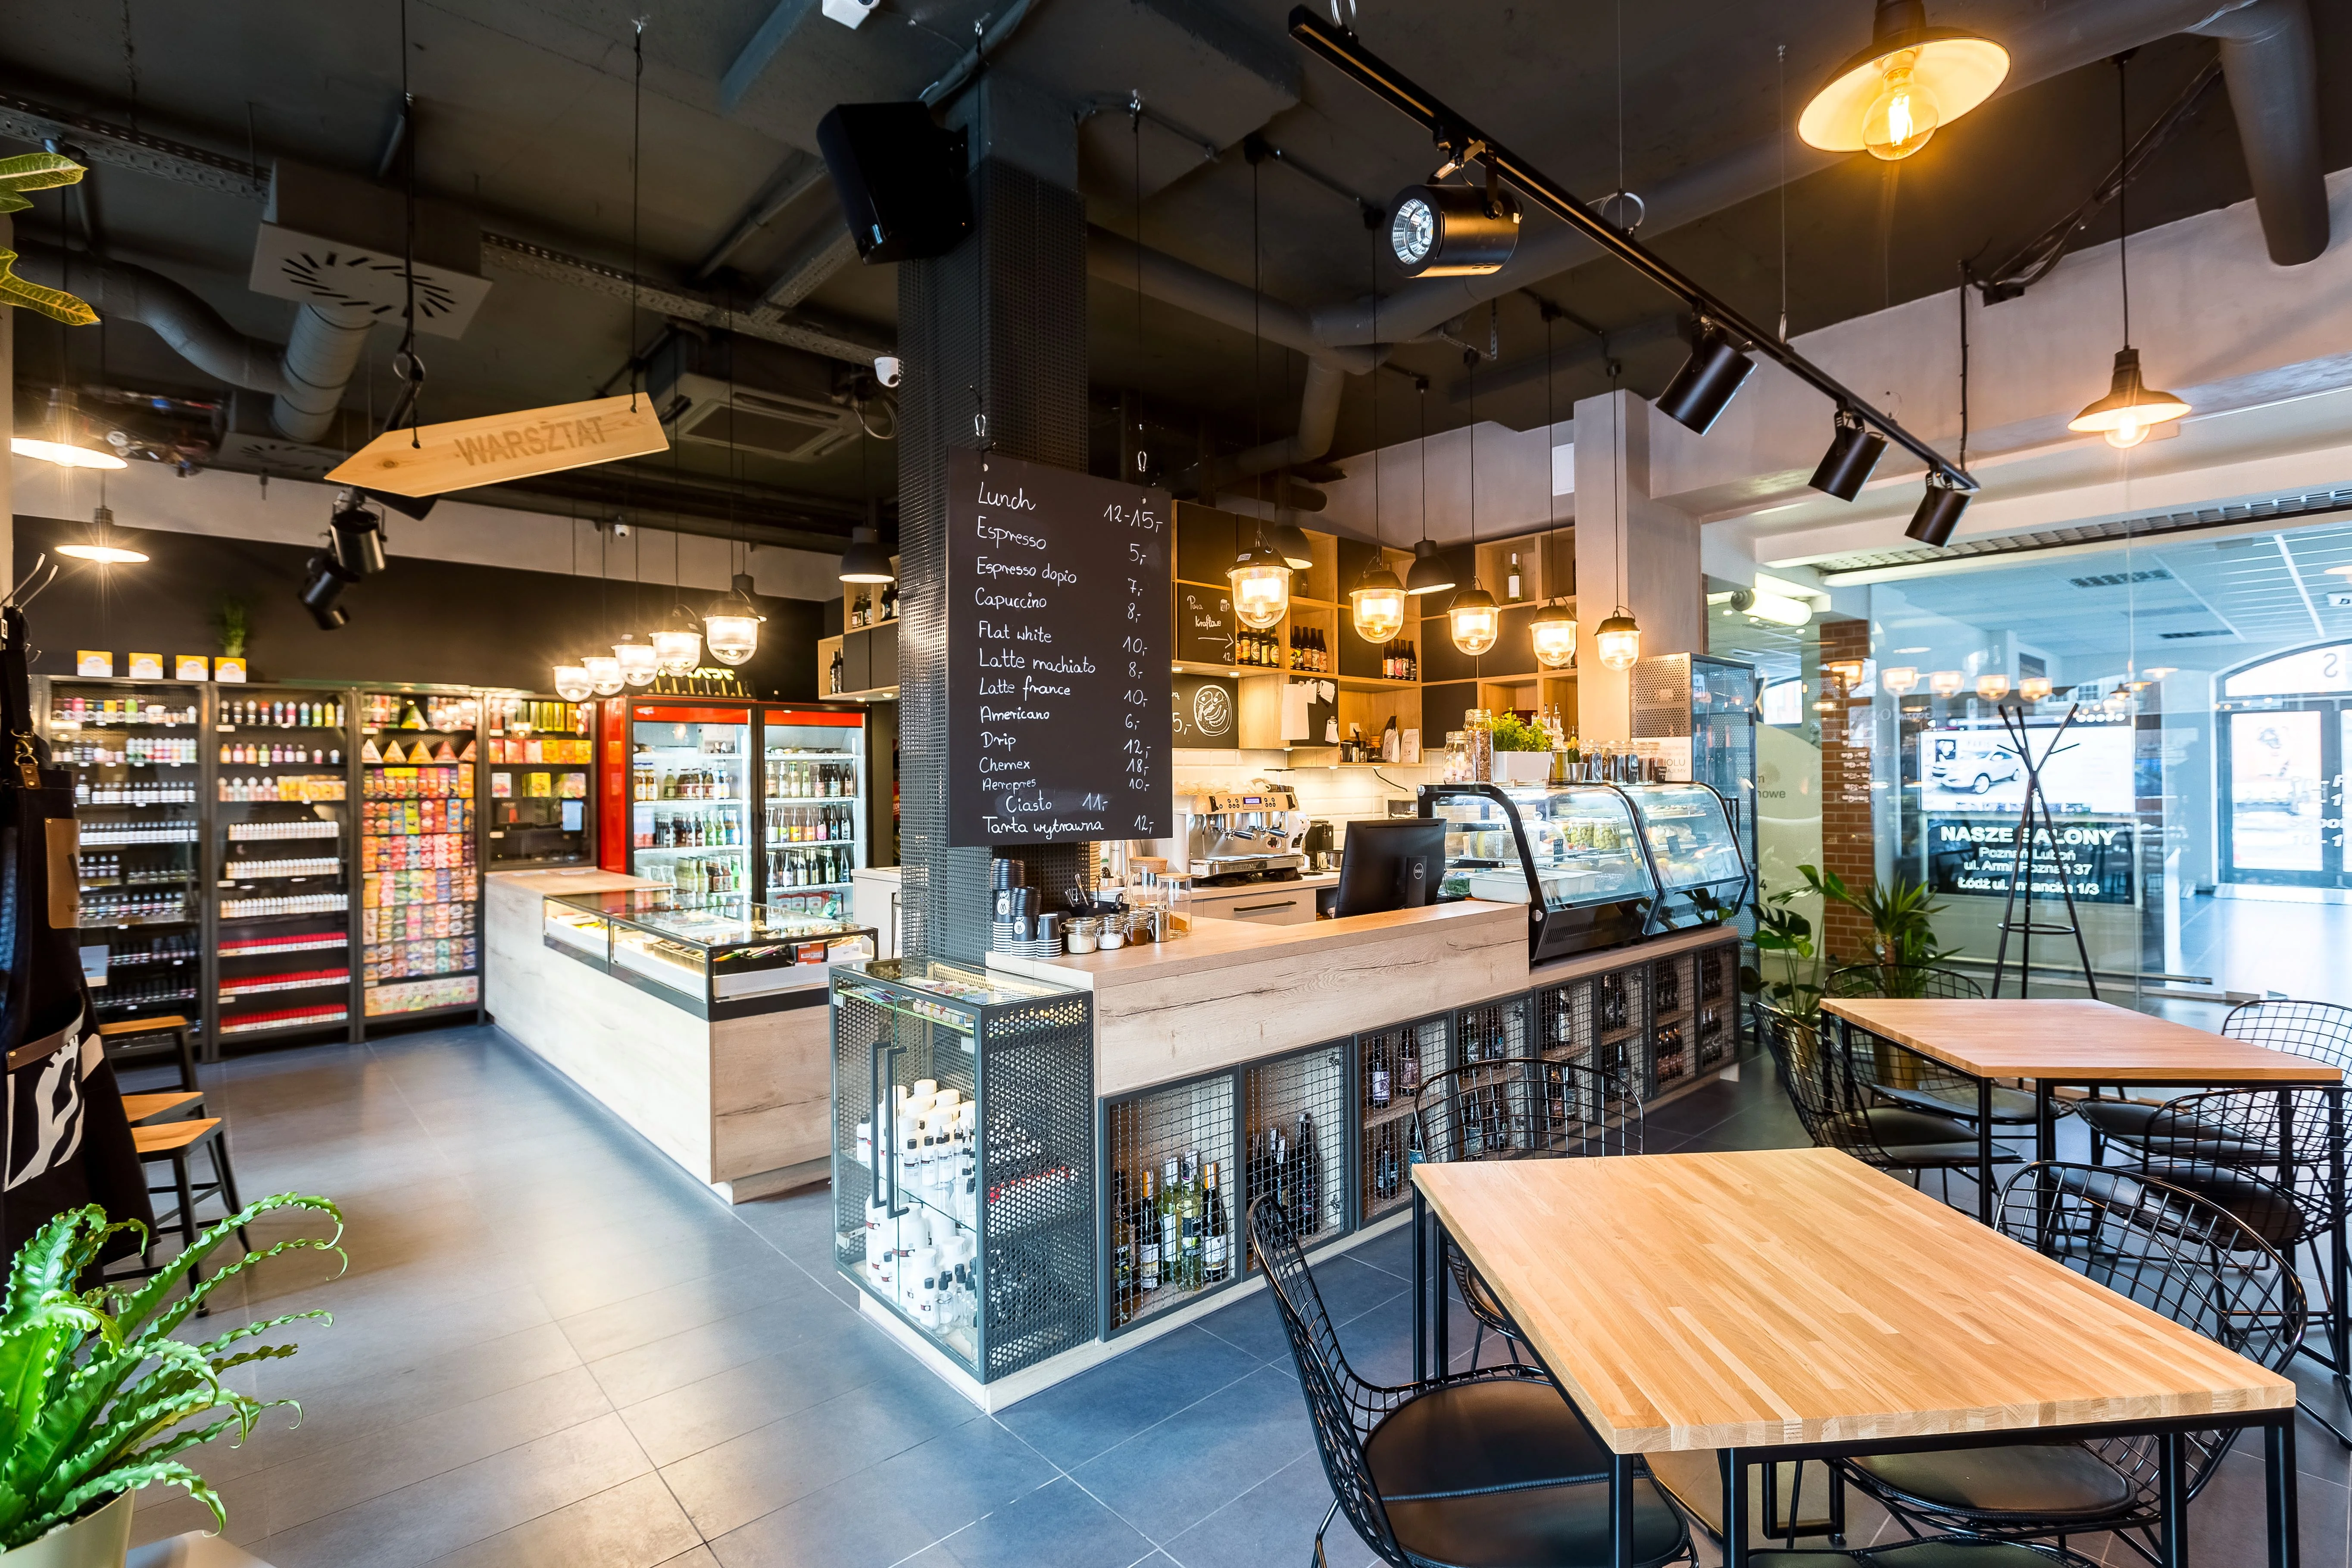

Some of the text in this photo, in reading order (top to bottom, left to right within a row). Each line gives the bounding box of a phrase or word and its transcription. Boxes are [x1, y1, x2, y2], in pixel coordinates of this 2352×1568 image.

[454, 416, 606, 466] WARSZTAT
[978, 481, 1036, 510] Lunch
[977, 515, 1046, 550] Espresso
[977, 556, 1037, 580] Espresso
[1042, 563, 1077, 587] dopio
[975, 587, 1047, 610] Capuccino
[979, 620, 1010, 639] Flat
[1017, 625, 1052, 643] white
[979, 647, 1025, 668] Latte
[1033, 655, 1096, 673] machiato
[979, 677, 1015, 695] Latte
[1022, 675, 1071, 701] france
[980, 706, 1050, 724] Americano
[980, 731, 1016, 752] Drip
[979, 757, 1031, 773] Chemex
[983, 778, 1036, 795] Aeropres
[1006, 788, 1052, 813] Ciasto
[982, 816, 1028, 834] Tarta
[1034, 818, 1105, 840] wytrawna
[1941, 826, 2013, 842] NASZE
[1964, 860, 1980, 871] ul.
[2073, 864, 2093, 875] 37
[1957, 877, 1991, 890] Łódź
[1992, 879, 2009, 890] ul.
[2076, 882, 2100, 895] 1/3
